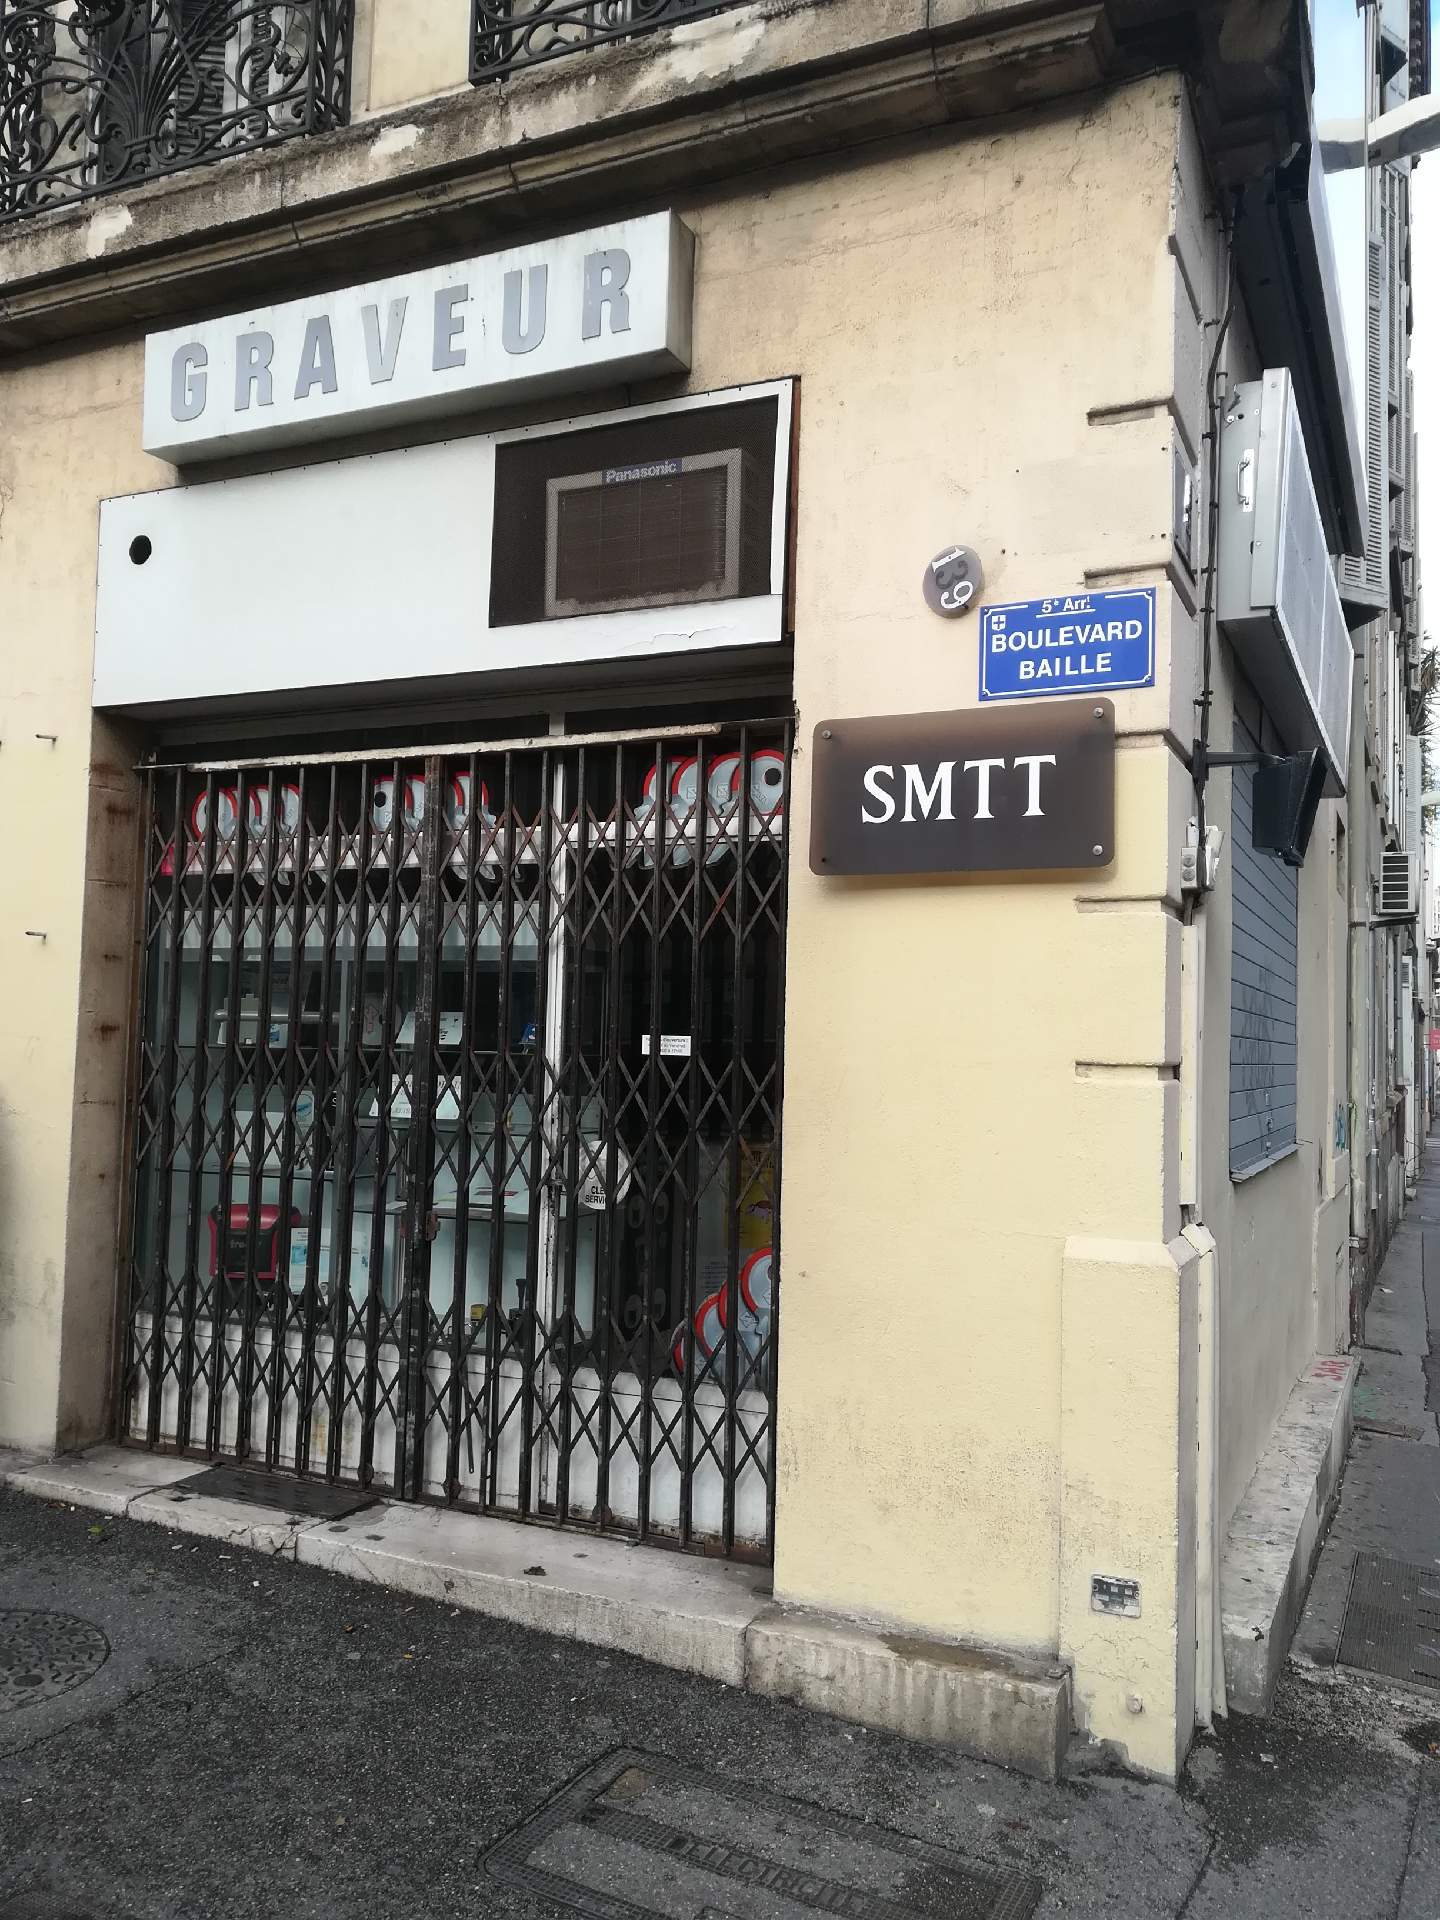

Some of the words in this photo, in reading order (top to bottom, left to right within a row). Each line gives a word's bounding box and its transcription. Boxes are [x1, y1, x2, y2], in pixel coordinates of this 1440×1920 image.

[169, 248, 632, 422] GRAVEUR
[606, 459, 678, 484] Panasonic
[991, 619, 1143, 653] BOULEVARD
[1019, 652, 1112, 680] BAILLE
[861, 754, 1056, 824] SMTT
[585, 1195, 605, 1203] SERVI
[591, 1186, 605, 1195] CLE
